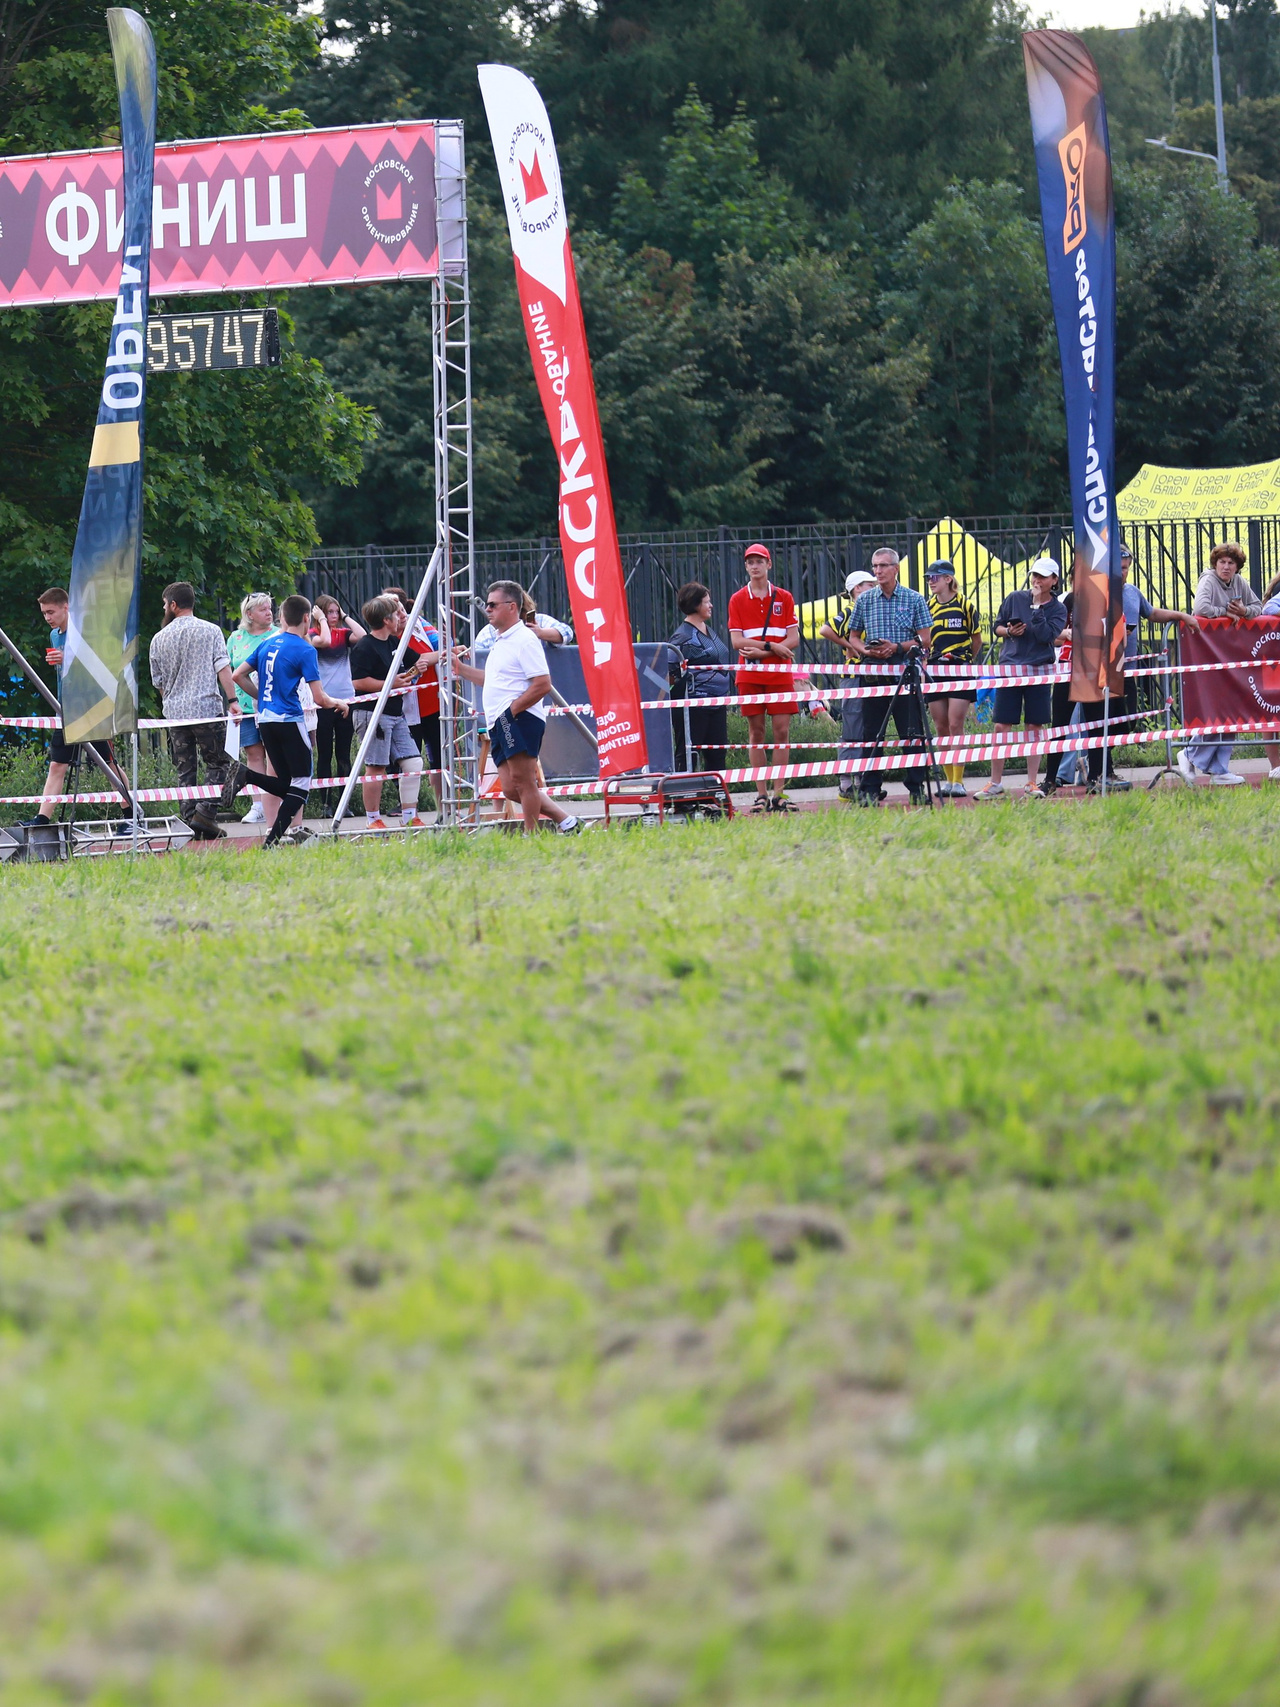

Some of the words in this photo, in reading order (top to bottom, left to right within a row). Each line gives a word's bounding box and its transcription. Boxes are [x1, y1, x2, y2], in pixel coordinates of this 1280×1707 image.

[364, 159, 414, 188] МОСКОВСКОЕ
[361, 202, 419, 244] ОРИЕНТИРОВАНИЕ
[263, 649, 280, 702] TEAM
